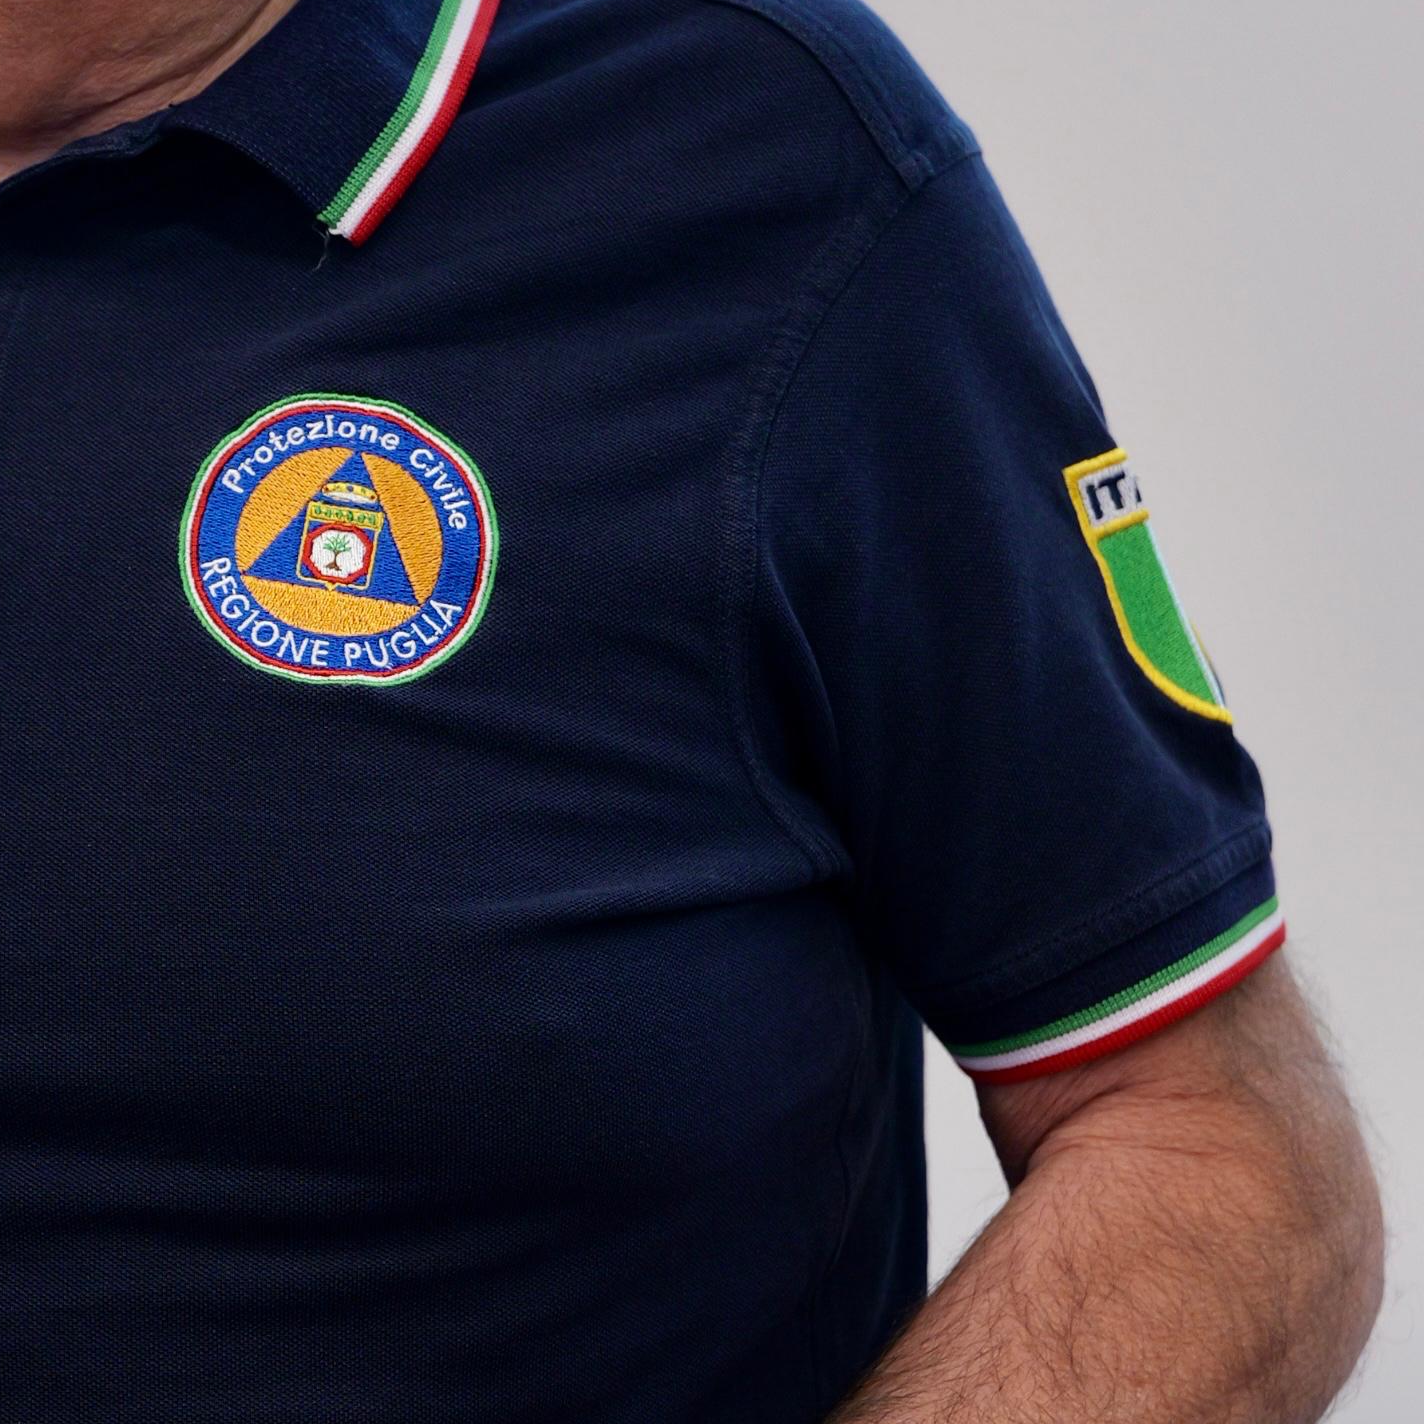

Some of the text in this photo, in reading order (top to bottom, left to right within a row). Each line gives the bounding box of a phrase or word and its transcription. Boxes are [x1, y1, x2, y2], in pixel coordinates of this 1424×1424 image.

[222, 415, 471, 531] Protezione Civile
[1086, 472, 1142, 520] IT
[201, 557, 462, 668] REGIONE PUGLIA
